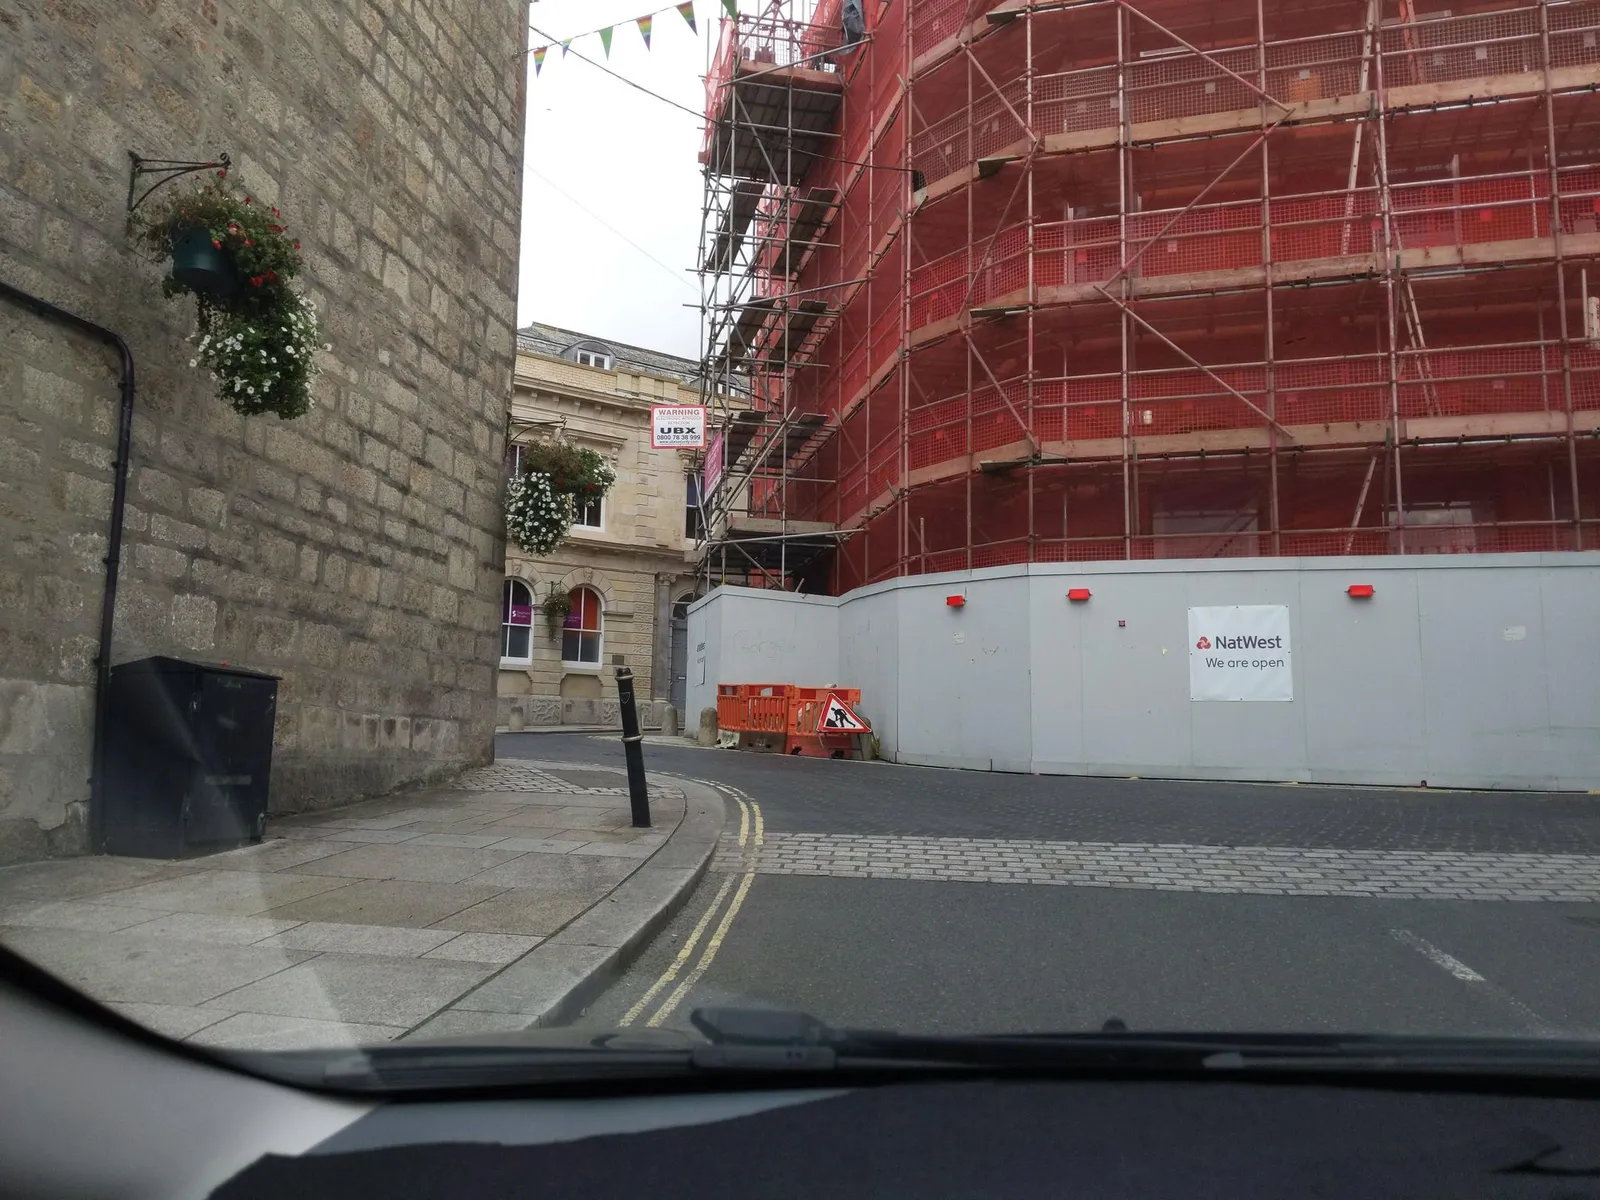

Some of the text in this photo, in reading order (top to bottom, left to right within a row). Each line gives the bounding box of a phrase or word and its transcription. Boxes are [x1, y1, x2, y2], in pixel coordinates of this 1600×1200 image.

[1215, 635, 1282, 649] NatWest
[1205, 657, 1285, 671] We are open
